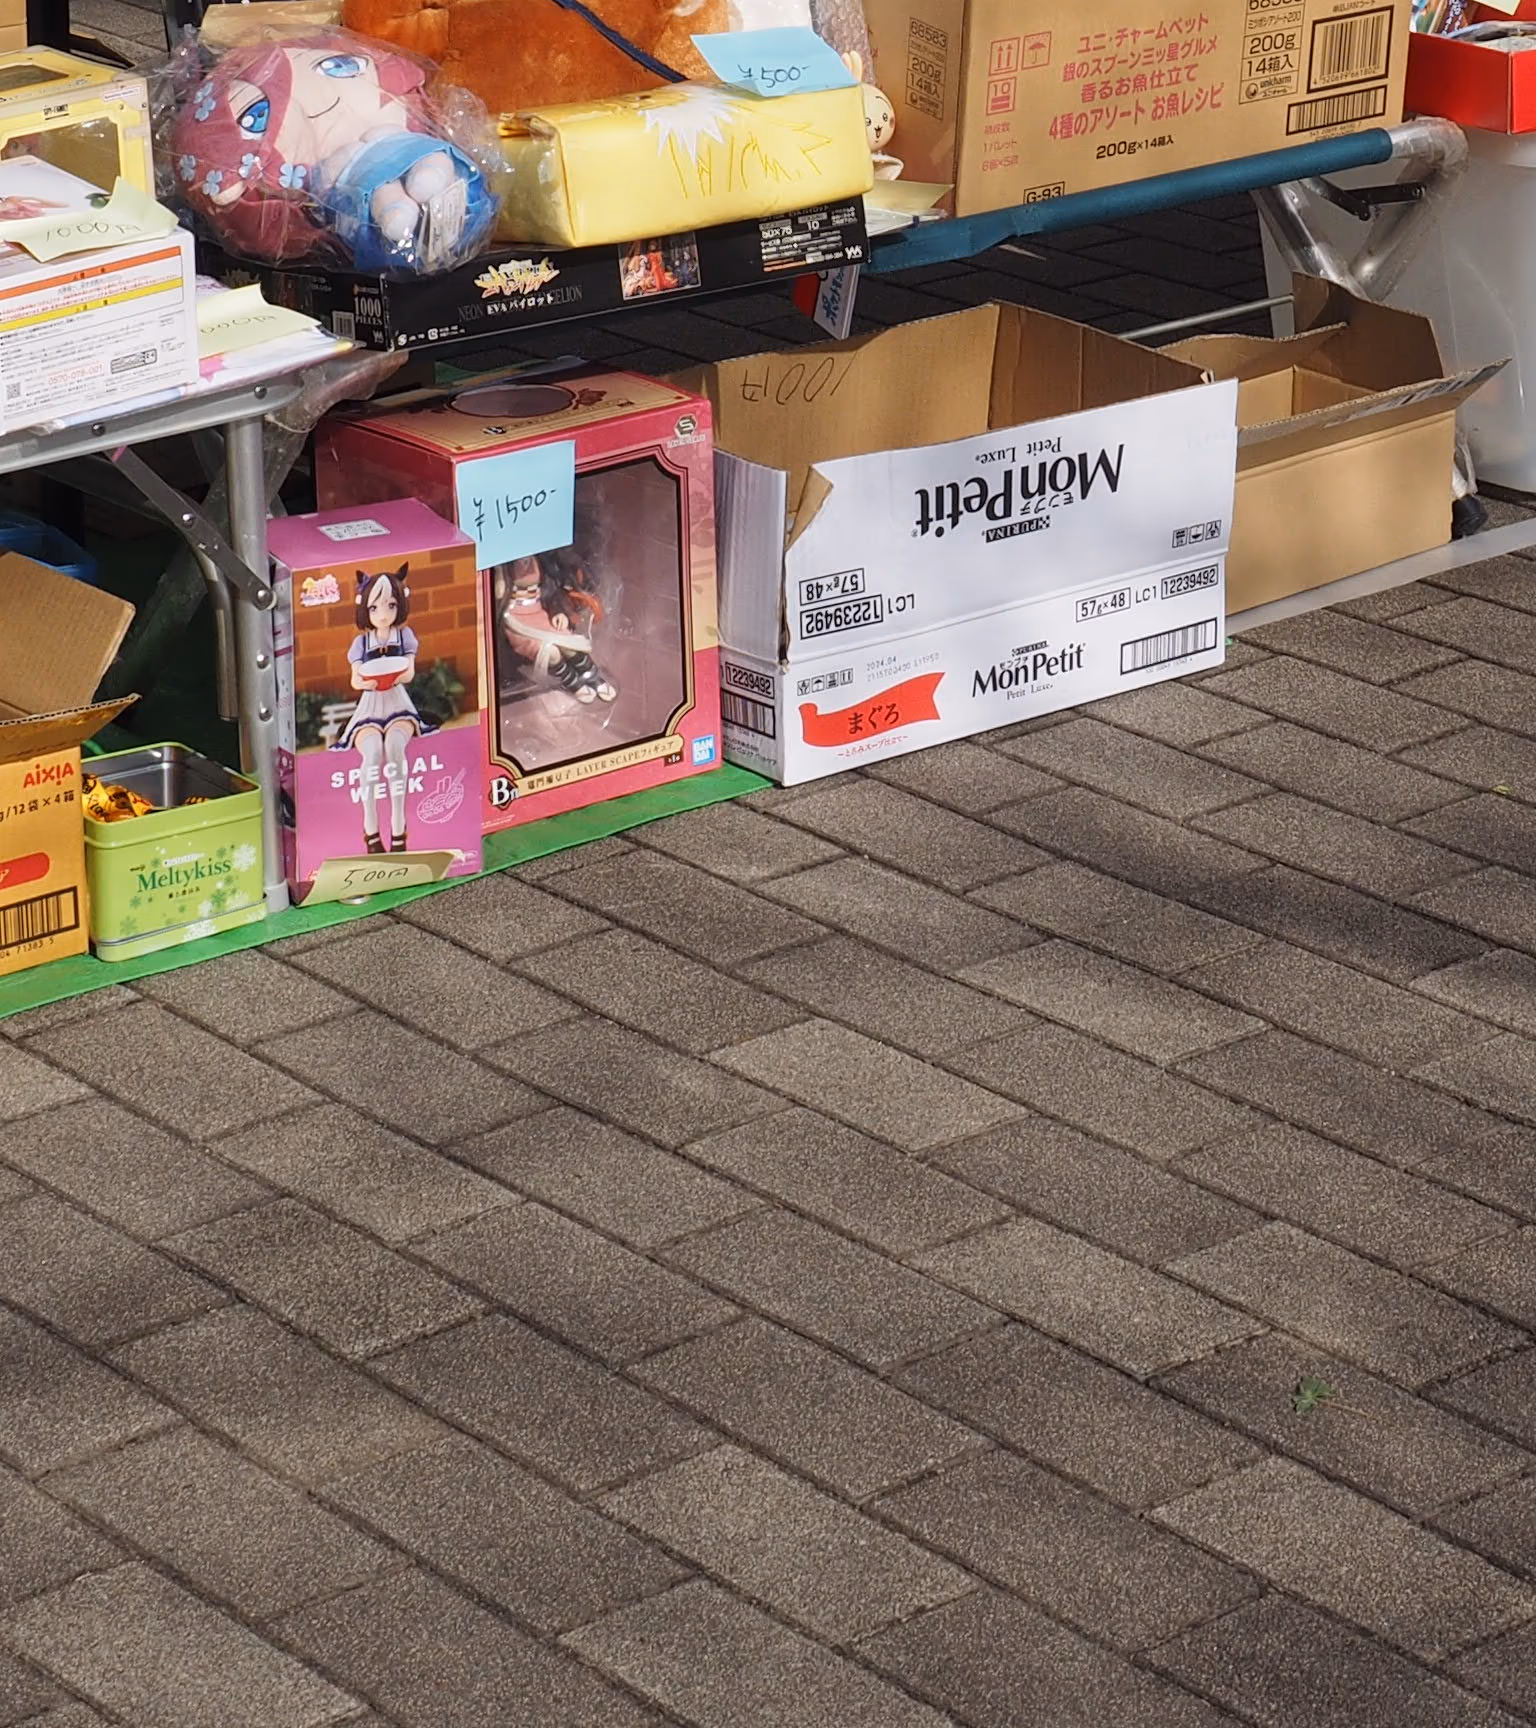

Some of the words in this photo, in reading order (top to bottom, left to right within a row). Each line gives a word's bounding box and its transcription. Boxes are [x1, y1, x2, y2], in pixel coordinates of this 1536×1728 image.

[1077, 13, 1209, 54] ユニ・チャームペット
[1249, 32, 1296, 55] 200g
[1247, 53, 1293, 77] 14箱入
[992, 82, 1011, 95] 10
[1080, 63, 1199, 104] 香るお魚仕立て
[1049, 99, 1146, 140] 4種のアソート
[1151, 82, 1225, 121] お魚レシピ
[1096, 133, 1175, 160] 200g×14箱入
[1026, 186, 1062, 206] G-93
[354, 295, 382, 317] 1000
[1027, 436, 1062, 458] Petit
[915, 444, 1125, 538] MonPetit
[986, 516, 1039, 543] PURINA
[1135, 585, 1157, 604] LC1
[1163, 567, 1217, 595] 12239492
[888, 593, 916, 615] LC1
[804, 599, 881, 638] 12239492
[726, 666, 772, 695] 12239492
[972, 643, 1085, 698] MonPetit
[1006, 684, 1027, 701] Petit
[847, 703, 900, 735] まぐろ
[330, 753, 445, 790] SPECIAL
[576, 760, 608, 777] LAYER
[349, 775, 424, 805] WEEK
[136, 858, 232, 893] Meltykiss
